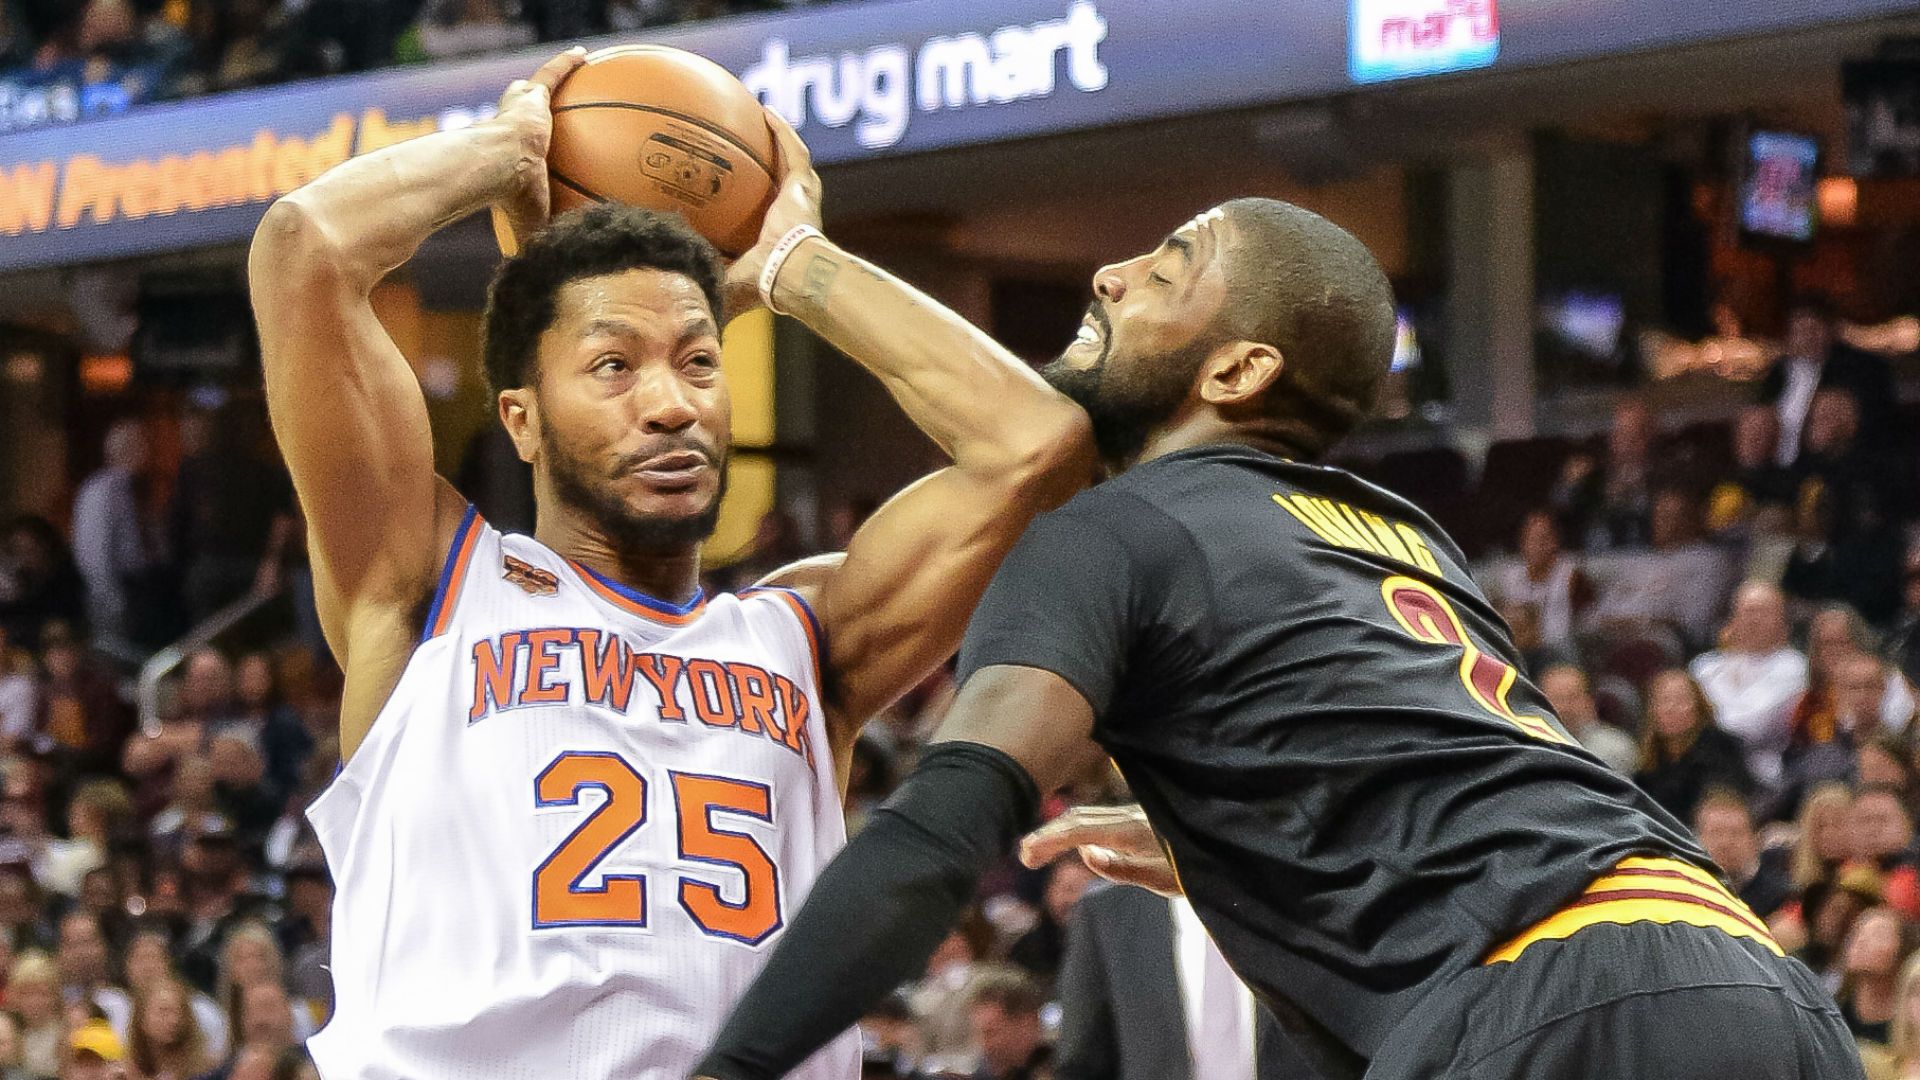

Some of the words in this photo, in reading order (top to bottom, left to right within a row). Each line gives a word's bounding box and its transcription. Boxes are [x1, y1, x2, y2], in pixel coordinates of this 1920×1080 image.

[742, 38, 911, 148] drug
[914, 0, 1109, 112] mart
[467, 627, 636, 727] NEW
[633, 652, 818, 777] YORK
[1380, 575, 1582, 748] 2
[531, 750, 785, 947] 25
